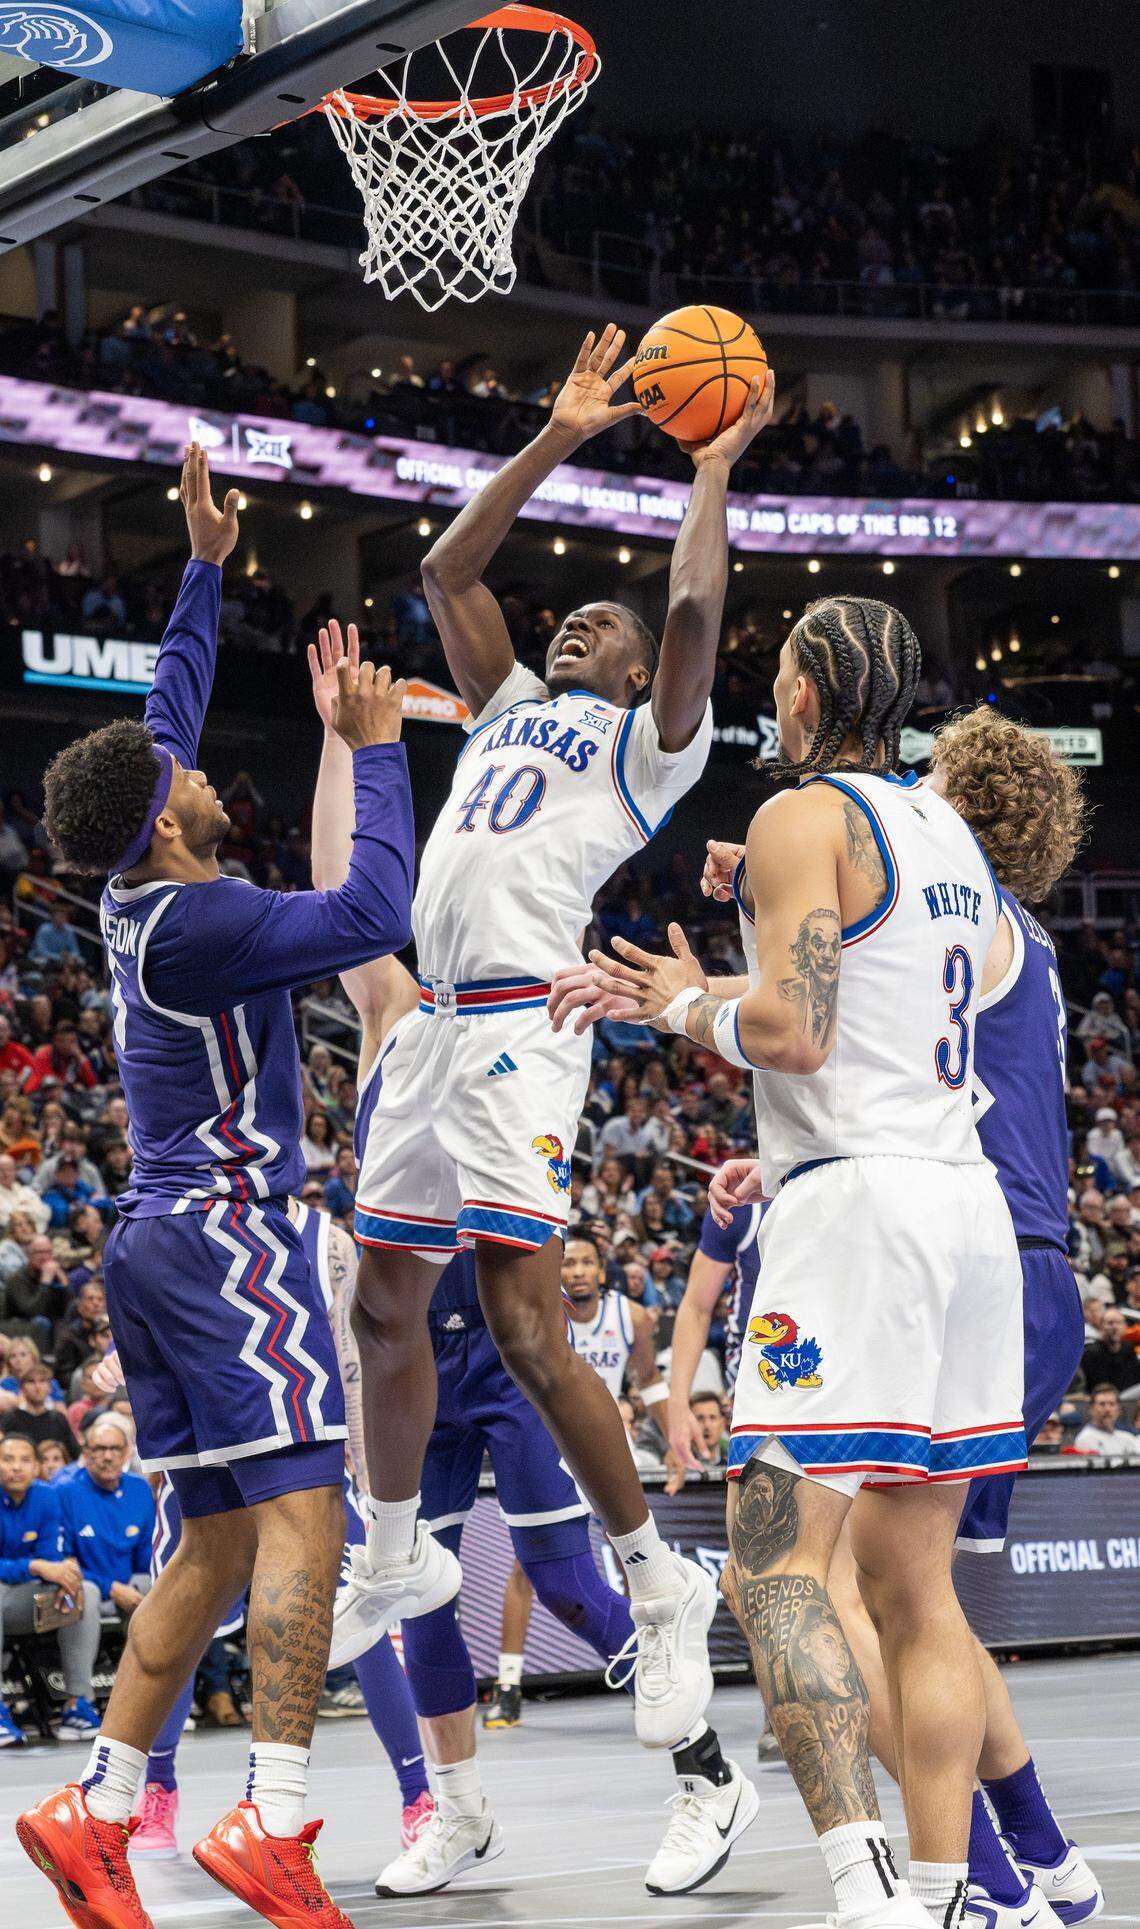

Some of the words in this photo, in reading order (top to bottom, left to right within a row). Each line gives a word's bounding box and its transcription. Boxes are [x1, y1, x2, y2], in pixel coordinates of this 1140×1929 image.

[396, 457, 464, 488] OFFICIAL
[581, 485, 639, 514] LOCKER
[750, 510, 785, 534] AND
[787, 513, 835, 535] CAPS
[837, 513, 861, 535] OF
[861, 514, 897, 536] THE
[899, 515, 930, 537] BIG
[933, 516, 957, 538] 12
[455, 764, 547, 835] 40
[921, 882, 981, 926] WHITE
[935, 944, 975, 1091] 3
[780, 1353, 802, 1369] KU
[1009, 1539, 1105, 1574] OFFICIAL
[742, 1579, 814, 1620] LEGENDS
